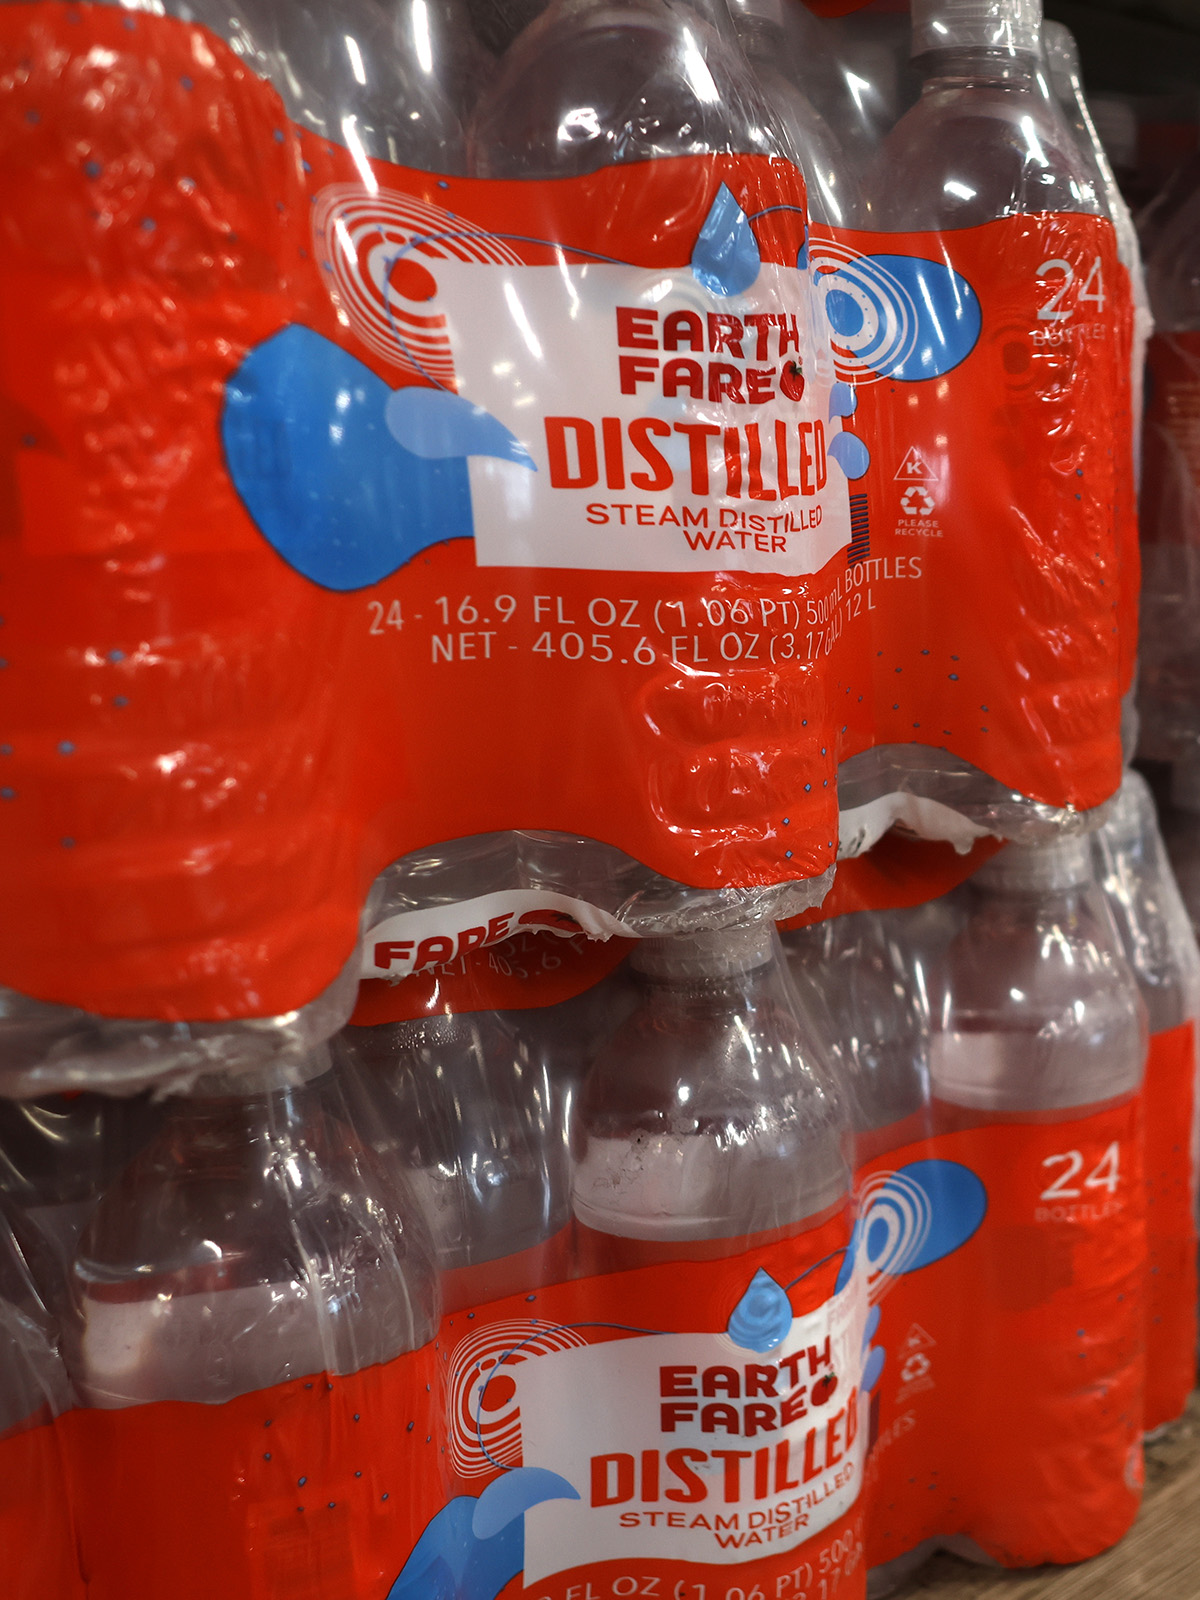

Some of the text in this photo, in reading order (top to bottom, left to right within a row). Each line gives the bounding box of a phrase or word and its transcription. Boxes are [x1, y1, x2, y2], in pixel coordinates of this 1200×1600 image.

[1035, 256, 1106, 320] 24
[616, 306, 800, 361] EARTH
[618, 355, 776, 404] FARE
[544, 417, 827, 501] DISTILLED
[906, 462, 922, 474] K
[586, 503, 822, 534] STEAM DISTILLED
[683, 530, 787, 553] WATER
[895, 528, 943, 537] RECYCLE
[897, 519, 939, 528] PLEASE
[368, 600, 404, 635] 24
[434, 594, 517, 625] 16.9
[533, 595, 575, 624] FL
[587, 598, 641, 628] OZ
[653, 597, 749, 634] (1.06
[760, 598, 799, 629] PT)
[806, 577, 843, 625] 500mL
[844, 556, 922, 593] BOTTLES
[431, 631, 496, 663] NET
[532, 631, 656, 665] 405.6
[672, 635, 708, 663] FL
[720, 632, 760, 659] OZ
[845, 592, 862, 621] 12
[867, 588, 876, 610] L
[1040, 1141, 1122, 1199] 24
[659, 1335, 831, 1399] EARTH
[660, 1385, 808, 1437] FARE
[590, 1386, 859, 1508] DISTILLED
[619, 1462, 855, 1532] STEAM DISTILLED
[713, 1513, 810, 1549] WATER
[612, 1575, 661, 1597] OZ
[775, 1562, 813, 1599] PT)
